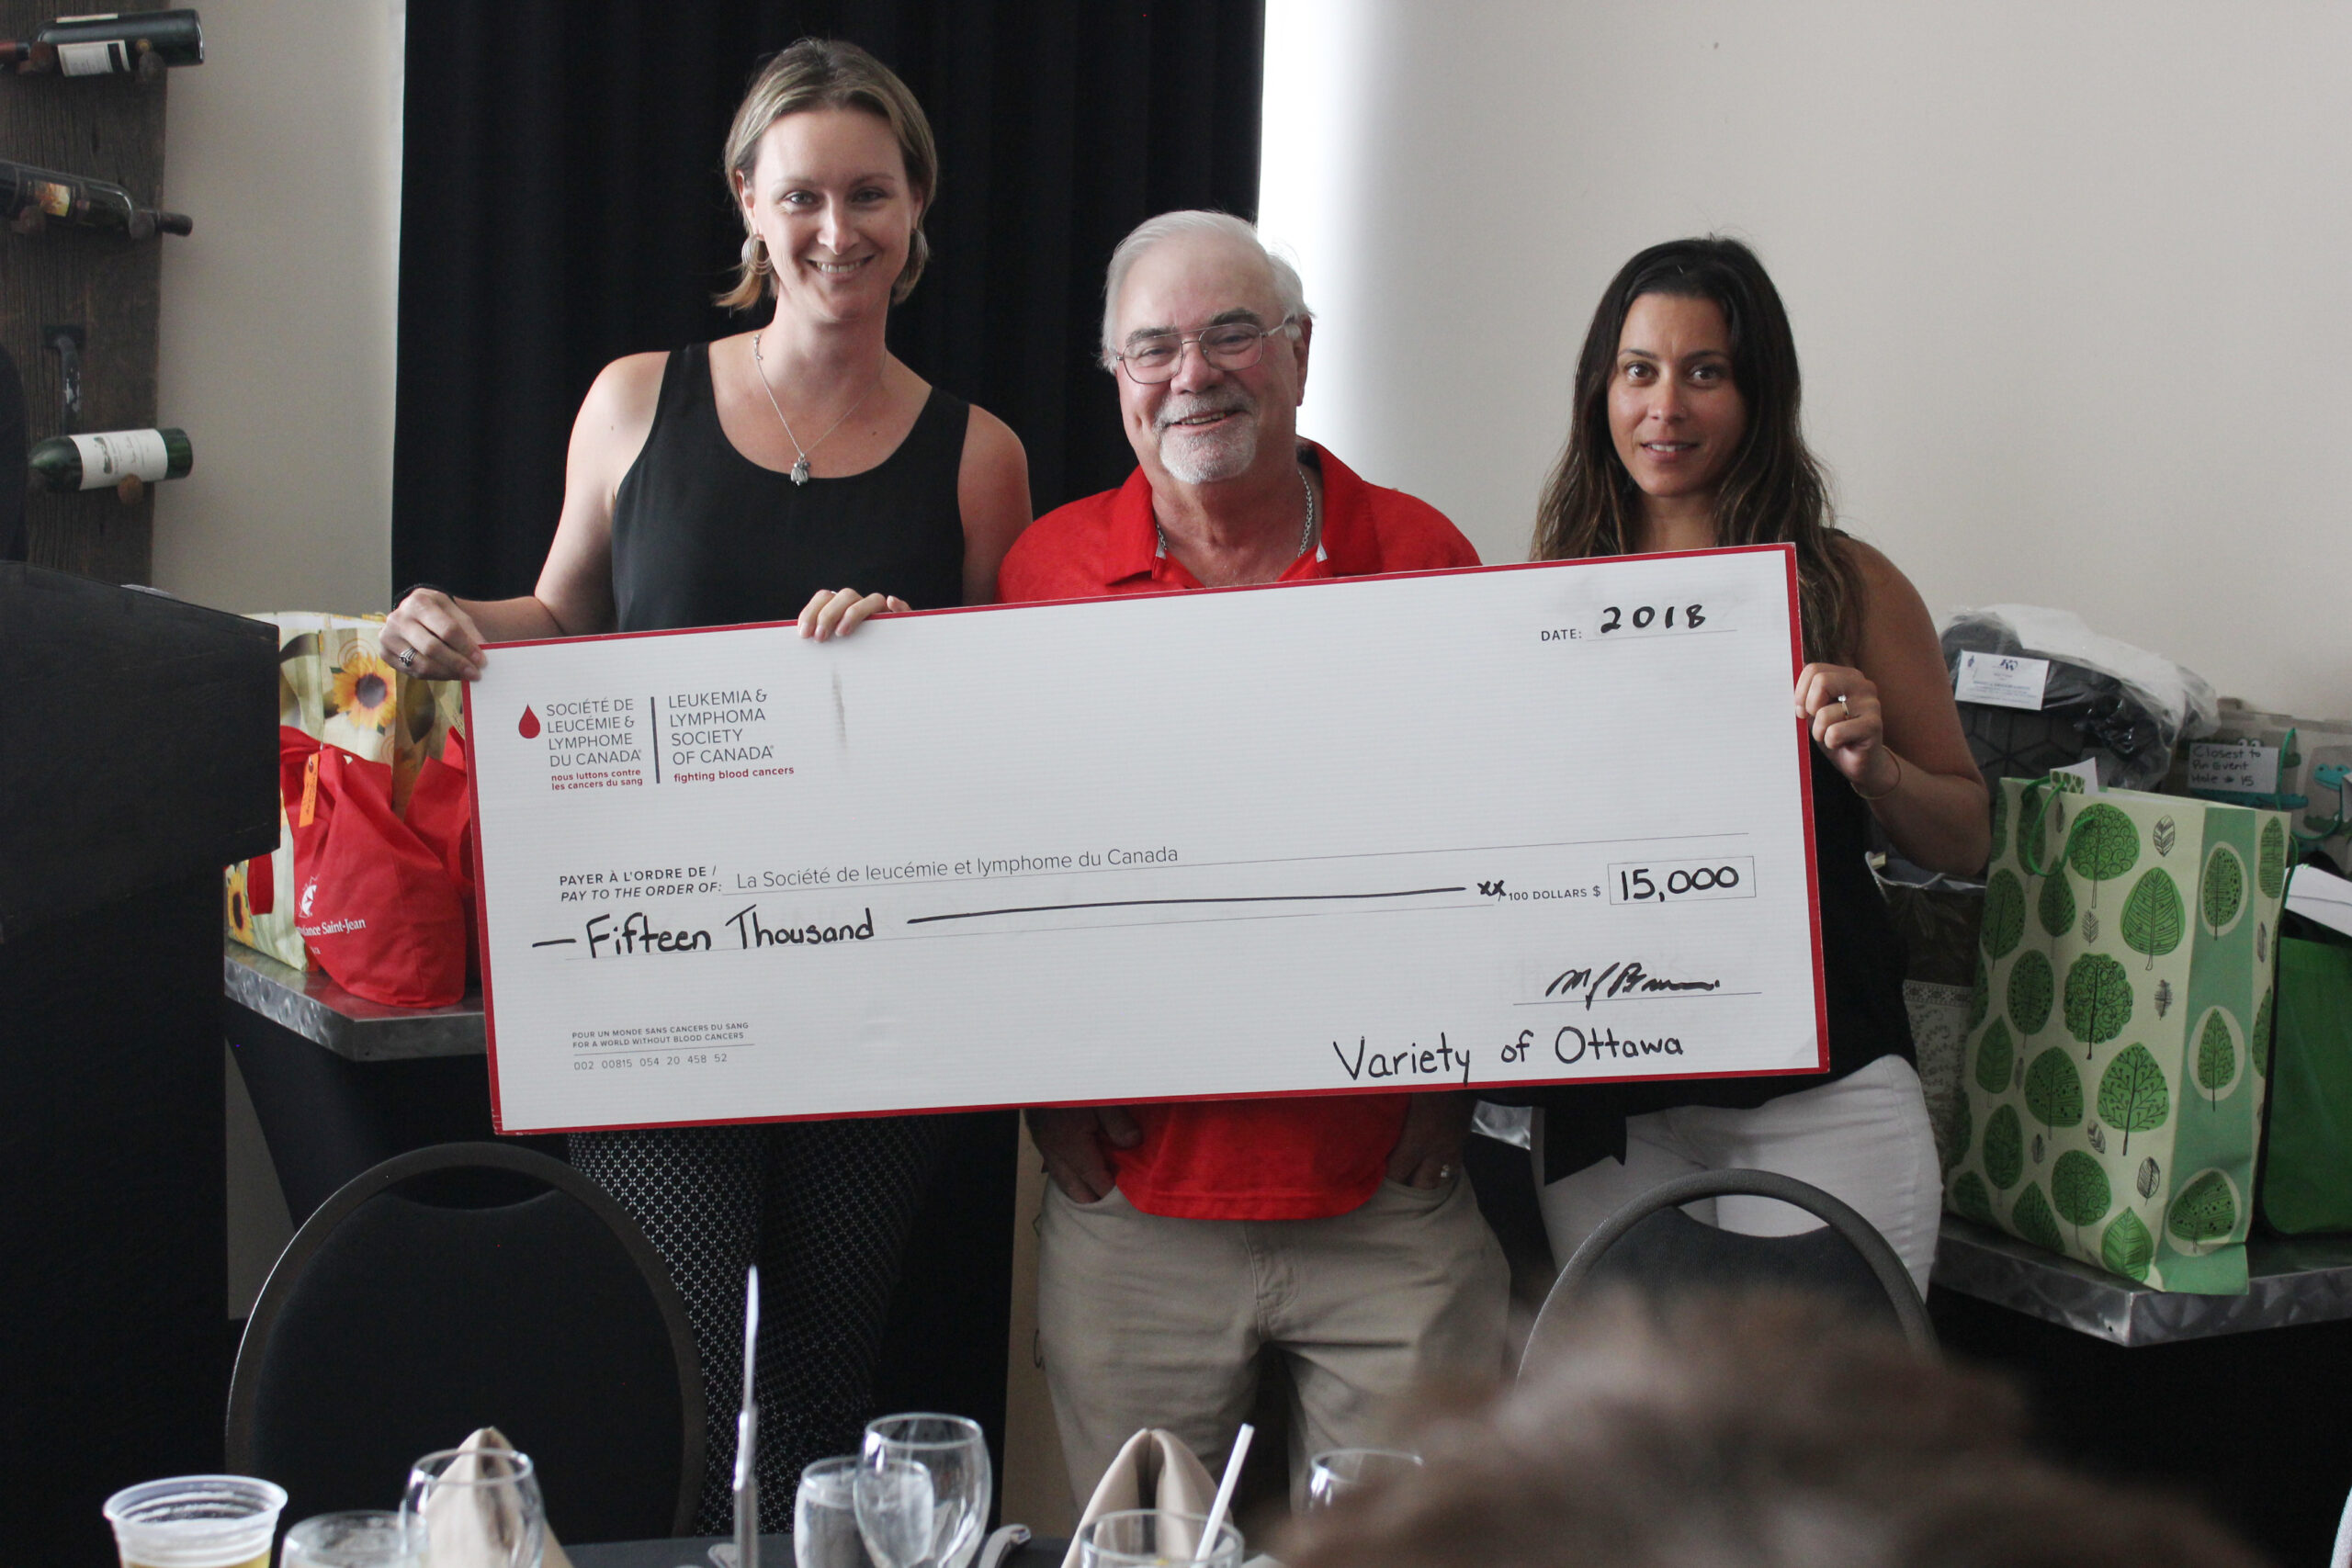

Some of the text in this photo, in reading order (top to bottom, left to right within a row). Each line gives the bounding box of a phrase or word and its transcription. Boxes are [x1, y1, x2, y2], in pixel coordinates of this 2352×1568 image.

[1600, 604, 1706, 634] 2018
[1541, 629, 1583, 641] DATE:
[546, 697, 634, 716] SOCIÉTÉ DE
[668, 689, 768, 708] LEUKEMIA &
[547, 716, 635, 734] LEUCÉMIE &
[670, 708, 766, 728] LYMPHOMA
[548, 733, 633, 750] LYMPHOME
[671, 729, 743, 747] SOCIETY
[549, 751, 571, 767] DU
[672, 750, 695, 766] OF
[2193, 745, 2261, 759] Closest to
[673, 766, 796, 784] fighting blood cancers
[2212, 761, 2248, 771] Event
[551, 769, 641, 782] nous luttons contre
[551, 782, 564, 791] les
[567, 780, 604, 790] cancers
[621, 778, 643, 788] sang
[2242, 775, 2255, 786] 15
[559, 874, 604, 886] PAYER
[609, 869, 619, 883] À
[624, 869, 682, 882] L'ORDRE
[687, 867, 707, 877] DE
[737, 846, 1178, 889] La Société de leucémie et lymphome du Canada
[560, 882, 722, 902] PAY TO THE ORDER OF:
[1532, 888, 1588, 900] DOLLARS
[1592, 885, 1601, 898] $
[1621, 865, 1740, 903] 15,000
[322, 918, 367, 935] Saint-Jean
[586, 903, 875, 959] Fifteen Thousand
[612, 1028, 643, 1036] MONDE
[645, 1027, 668, 1035] SANS
[670, 1025, 709, 1033] CANCERS
[632, 1037, 671, 1045] WITHOUT
[673, 1034, 702, 1043] BLOOD
[705, 1032, 745, 1041] CANCERS
[573, 1053, 728, 1071] 002 00815 054 20 458 52
[1332, 1025, 1685, 1088] Variety of Ottawa
